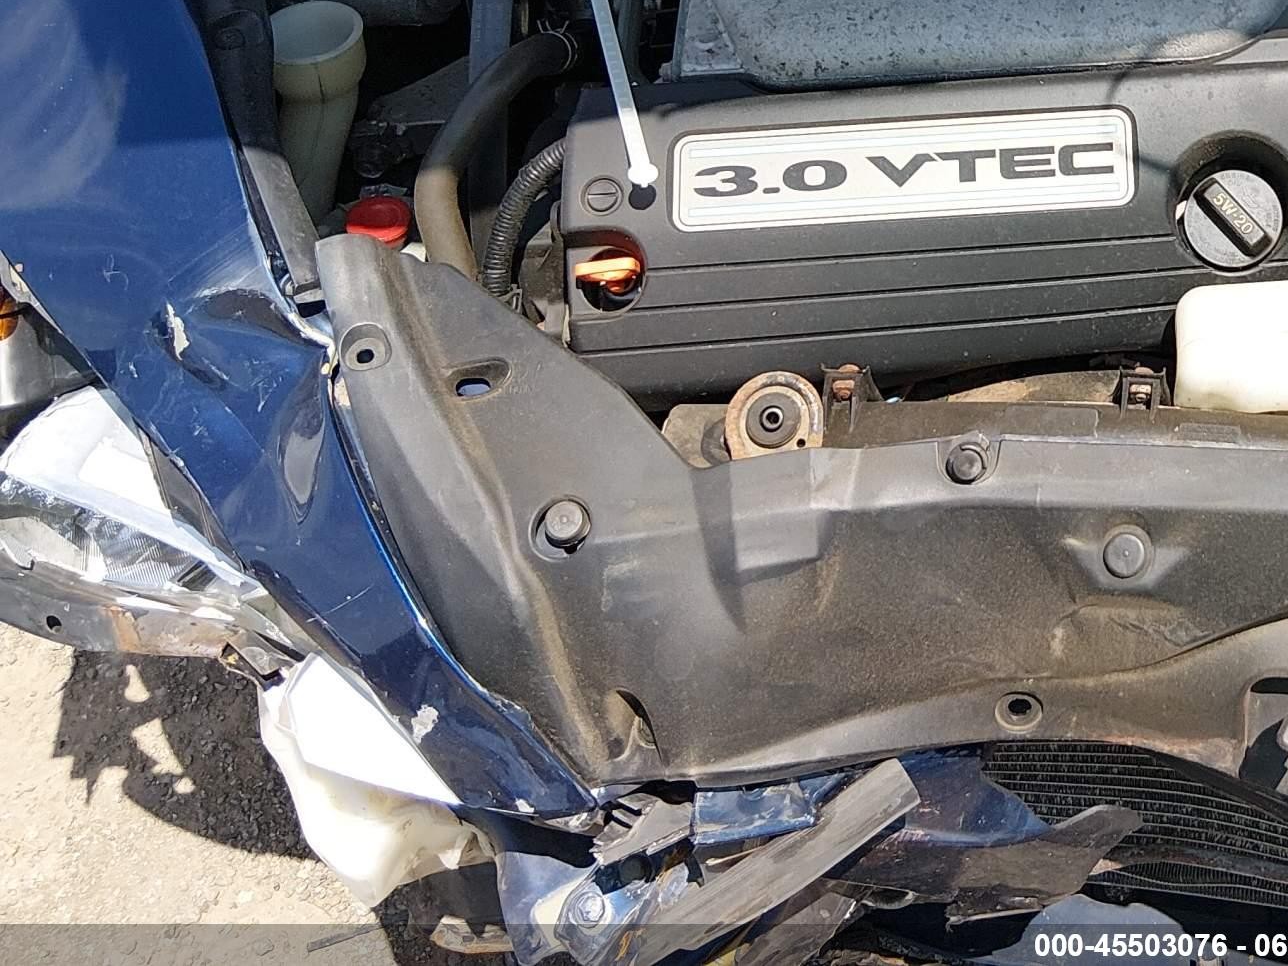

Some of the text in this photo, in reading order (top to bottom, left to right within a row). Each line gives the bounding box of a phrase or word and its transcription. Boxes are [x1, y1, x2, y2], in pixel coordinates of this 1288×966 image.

[692, 140, 1116, 200] 3.0 VTEC
[1213, 193, 1254, 234] 5W-20
